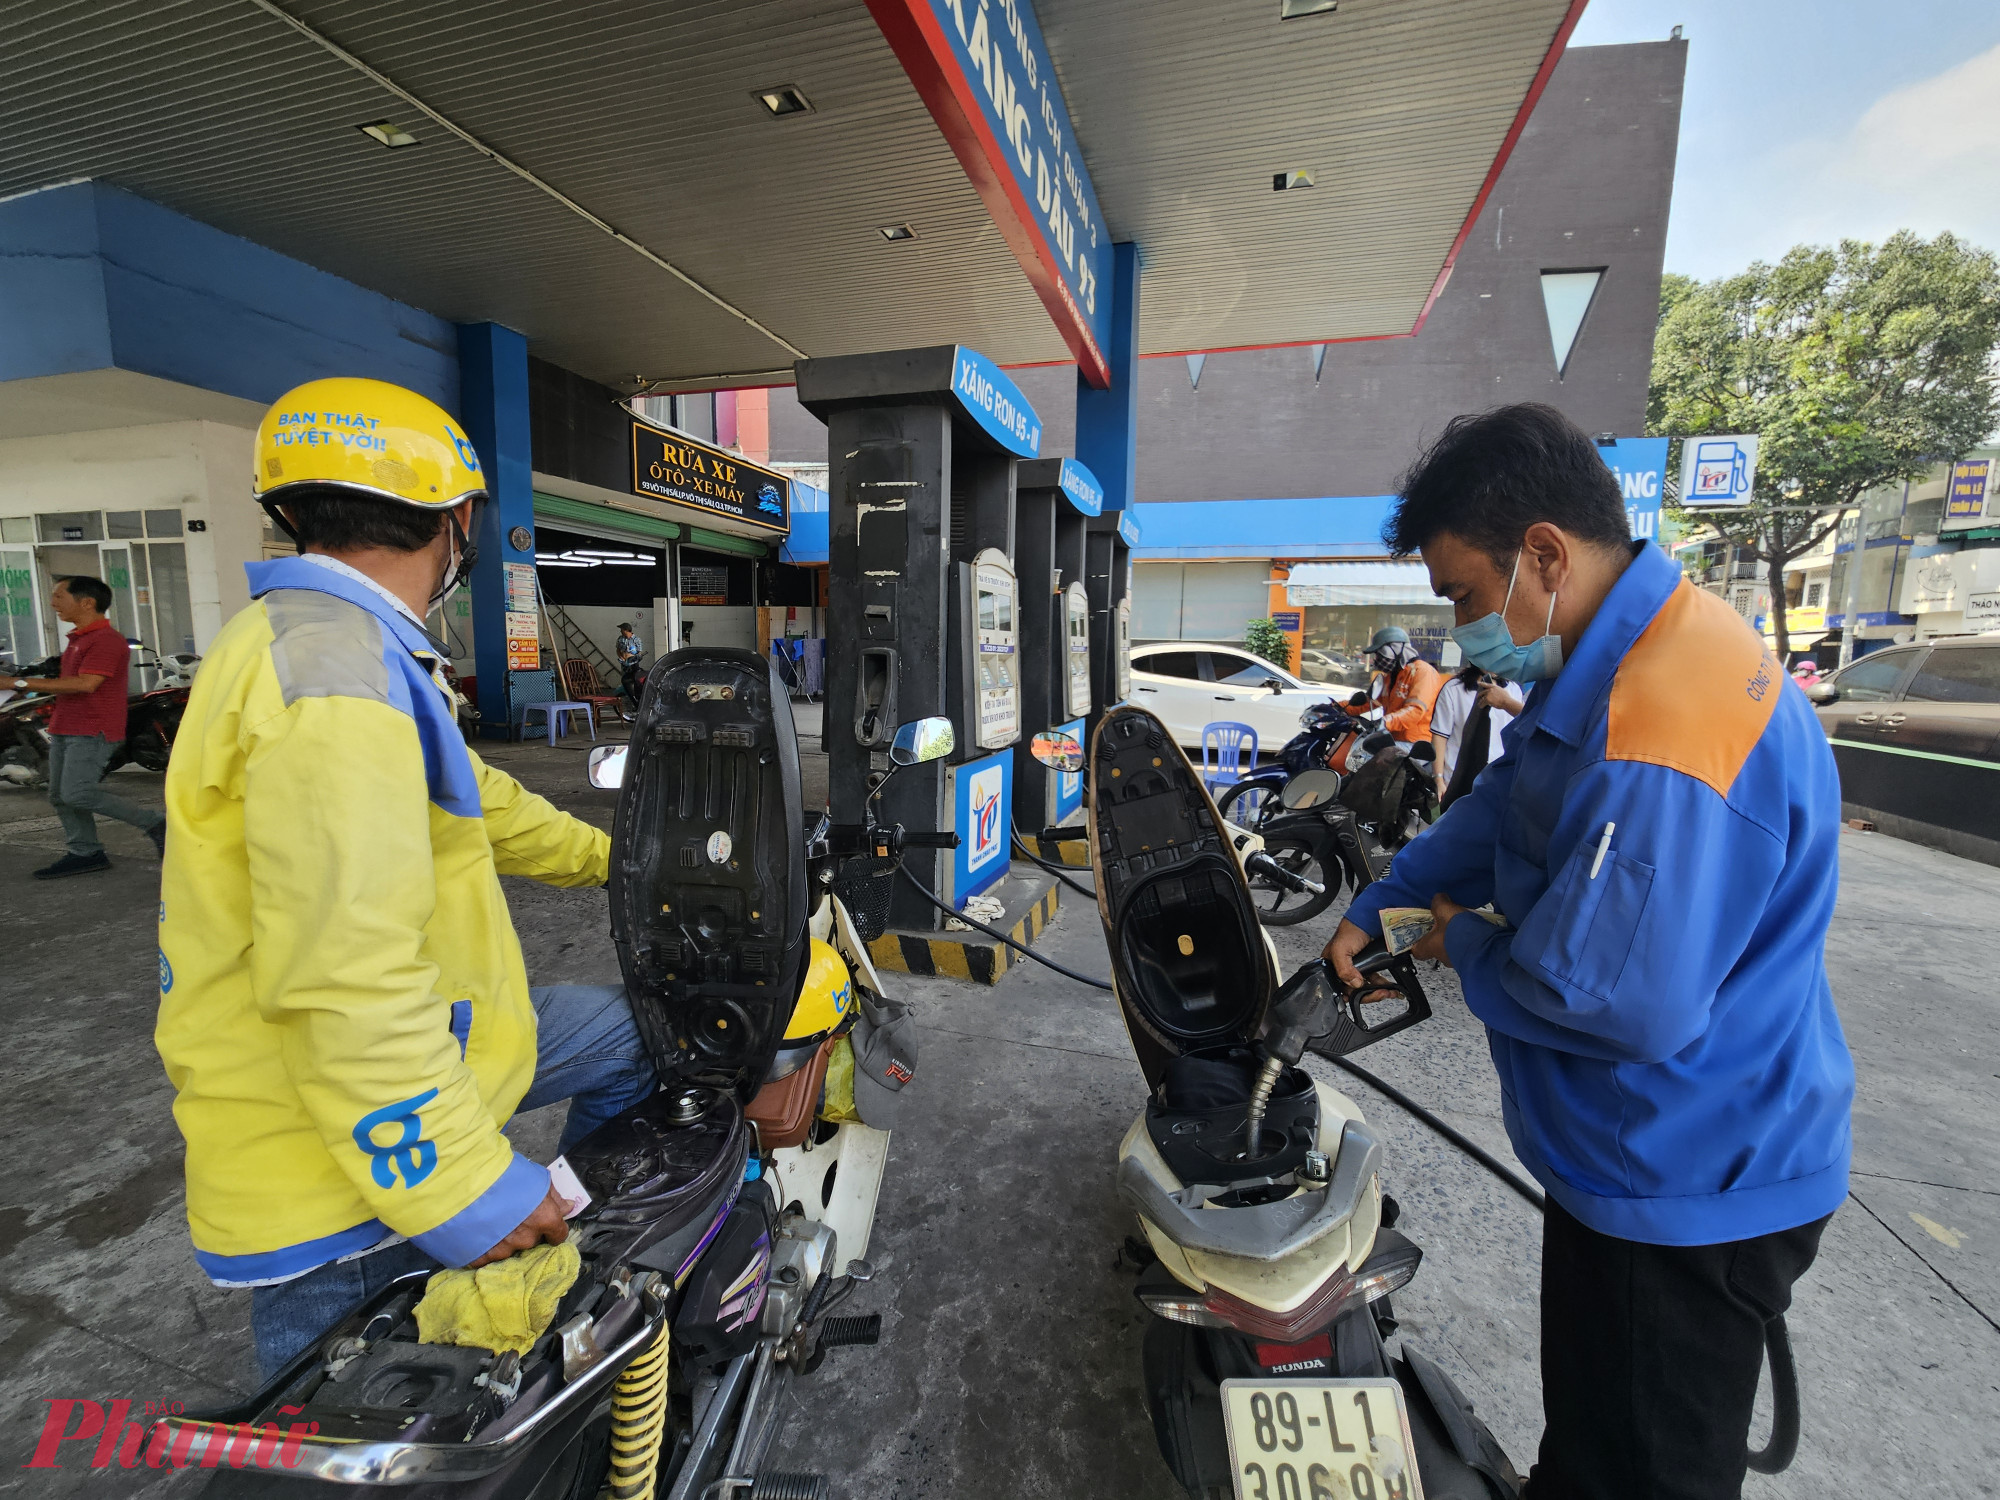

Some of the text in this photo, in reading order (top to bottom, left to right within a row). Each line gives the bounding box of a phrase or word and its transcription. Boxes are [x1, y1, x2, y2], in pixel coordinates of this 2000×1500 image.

[1063, 151, 1089, 230] QUẬN
[1090, 223, 1097, 249] 3
[1036, 146, 1075, 272] DẦU
[1078, 253, 1096, 315] 93
[959, 359, 993, 412] XĂNG
[993, 391, 1016, 432] RON
[1015, 411, 1027, 441] 95
[272, 427, 387, 452] TUYỆT VỜI!
[278, 411, 380, 433] BẠN THẬT
[663, 442, 737, 484] RỬA XE
[1063, 466, 1080, 495] XĂNG
[715, 485, 745, 504] MÁY
[1272, 1359, 1326, 1374] HONDA
[1250, 1390, 1379, 1453] 89-L1
